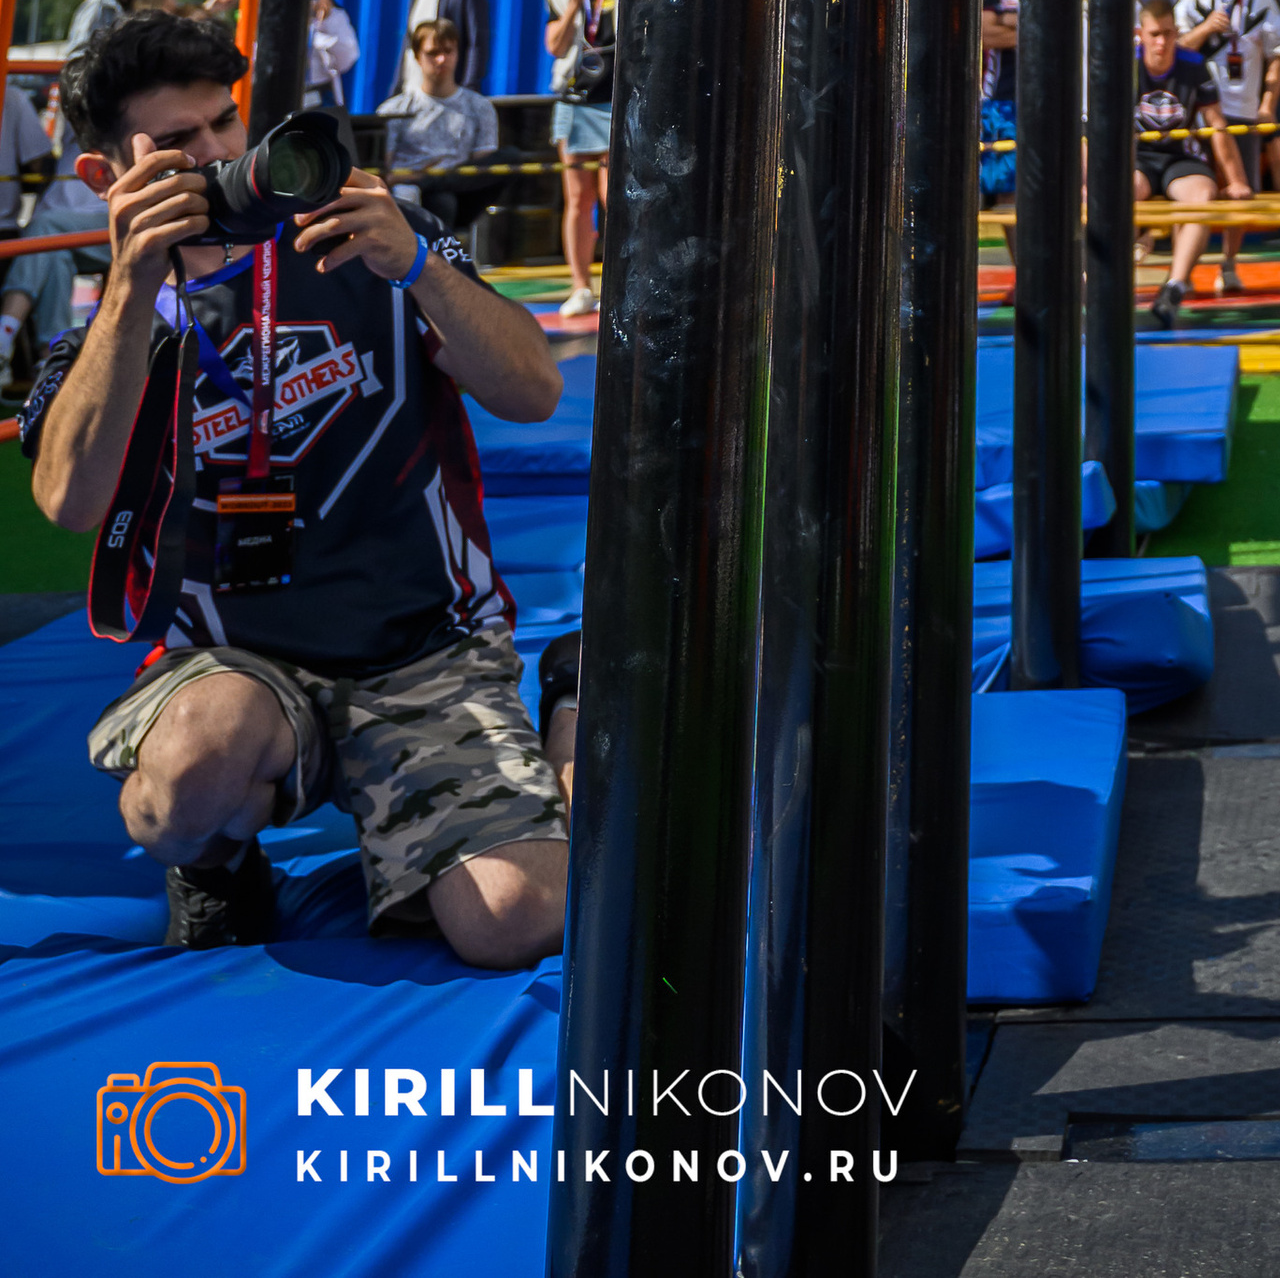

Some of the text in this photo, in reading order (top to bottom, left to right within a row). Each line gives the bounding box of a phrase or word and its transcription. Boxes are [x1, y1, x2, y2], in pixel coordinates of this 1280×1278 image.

[260, 279, 273, 386] МЕЖРЕГИОНАЛЬНЫЙ
[272, 349, 357, 411] OTHERS
[107, 510, 134, 548] EOS
